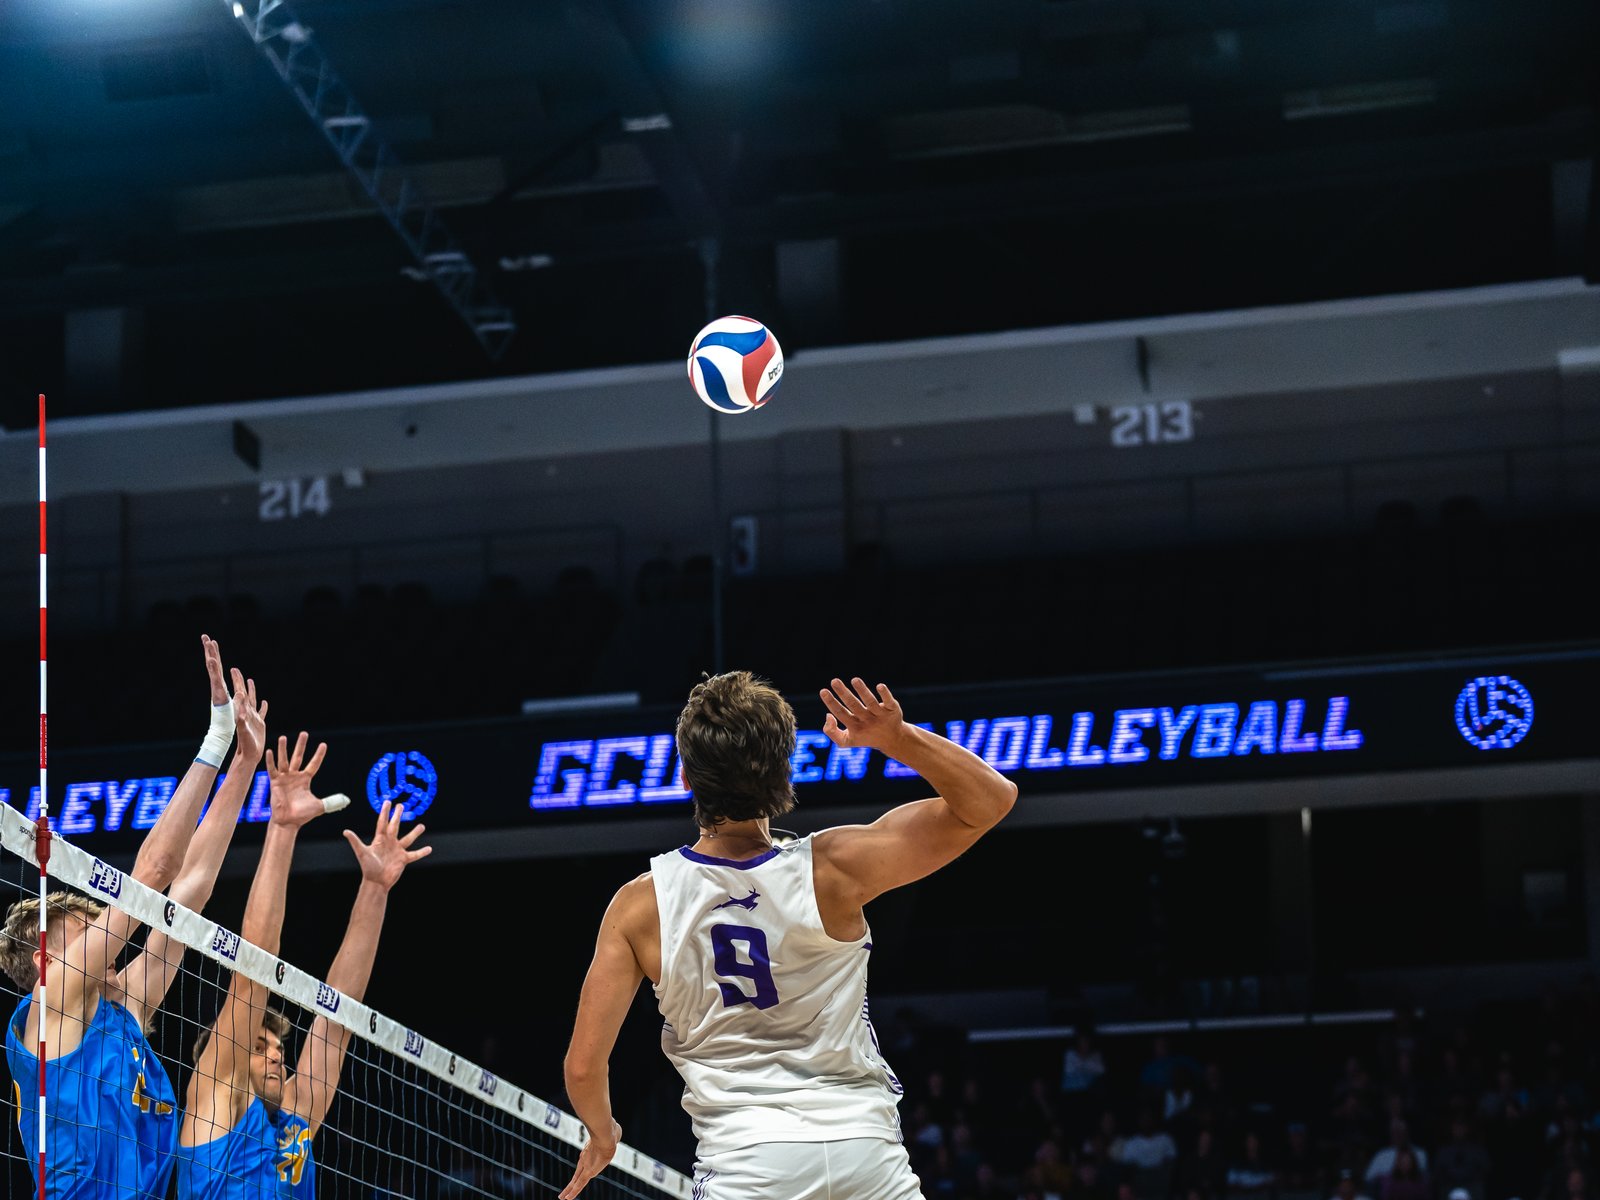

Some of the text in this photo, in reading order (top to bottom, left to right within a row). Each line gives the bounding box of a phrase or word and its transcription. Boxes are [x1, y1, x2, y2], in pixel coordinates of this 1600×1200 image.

[1110, 401, 1194, 447] 213
[259, 478, 332, 519] 214
[530, 733, 692, 809] GCU
[89, 858, 122, 899] GCU
[212, 926, 241, 961] GCU
[316, 981, 340, 1014] GCU
[710, 923, 780, 1011] 9
